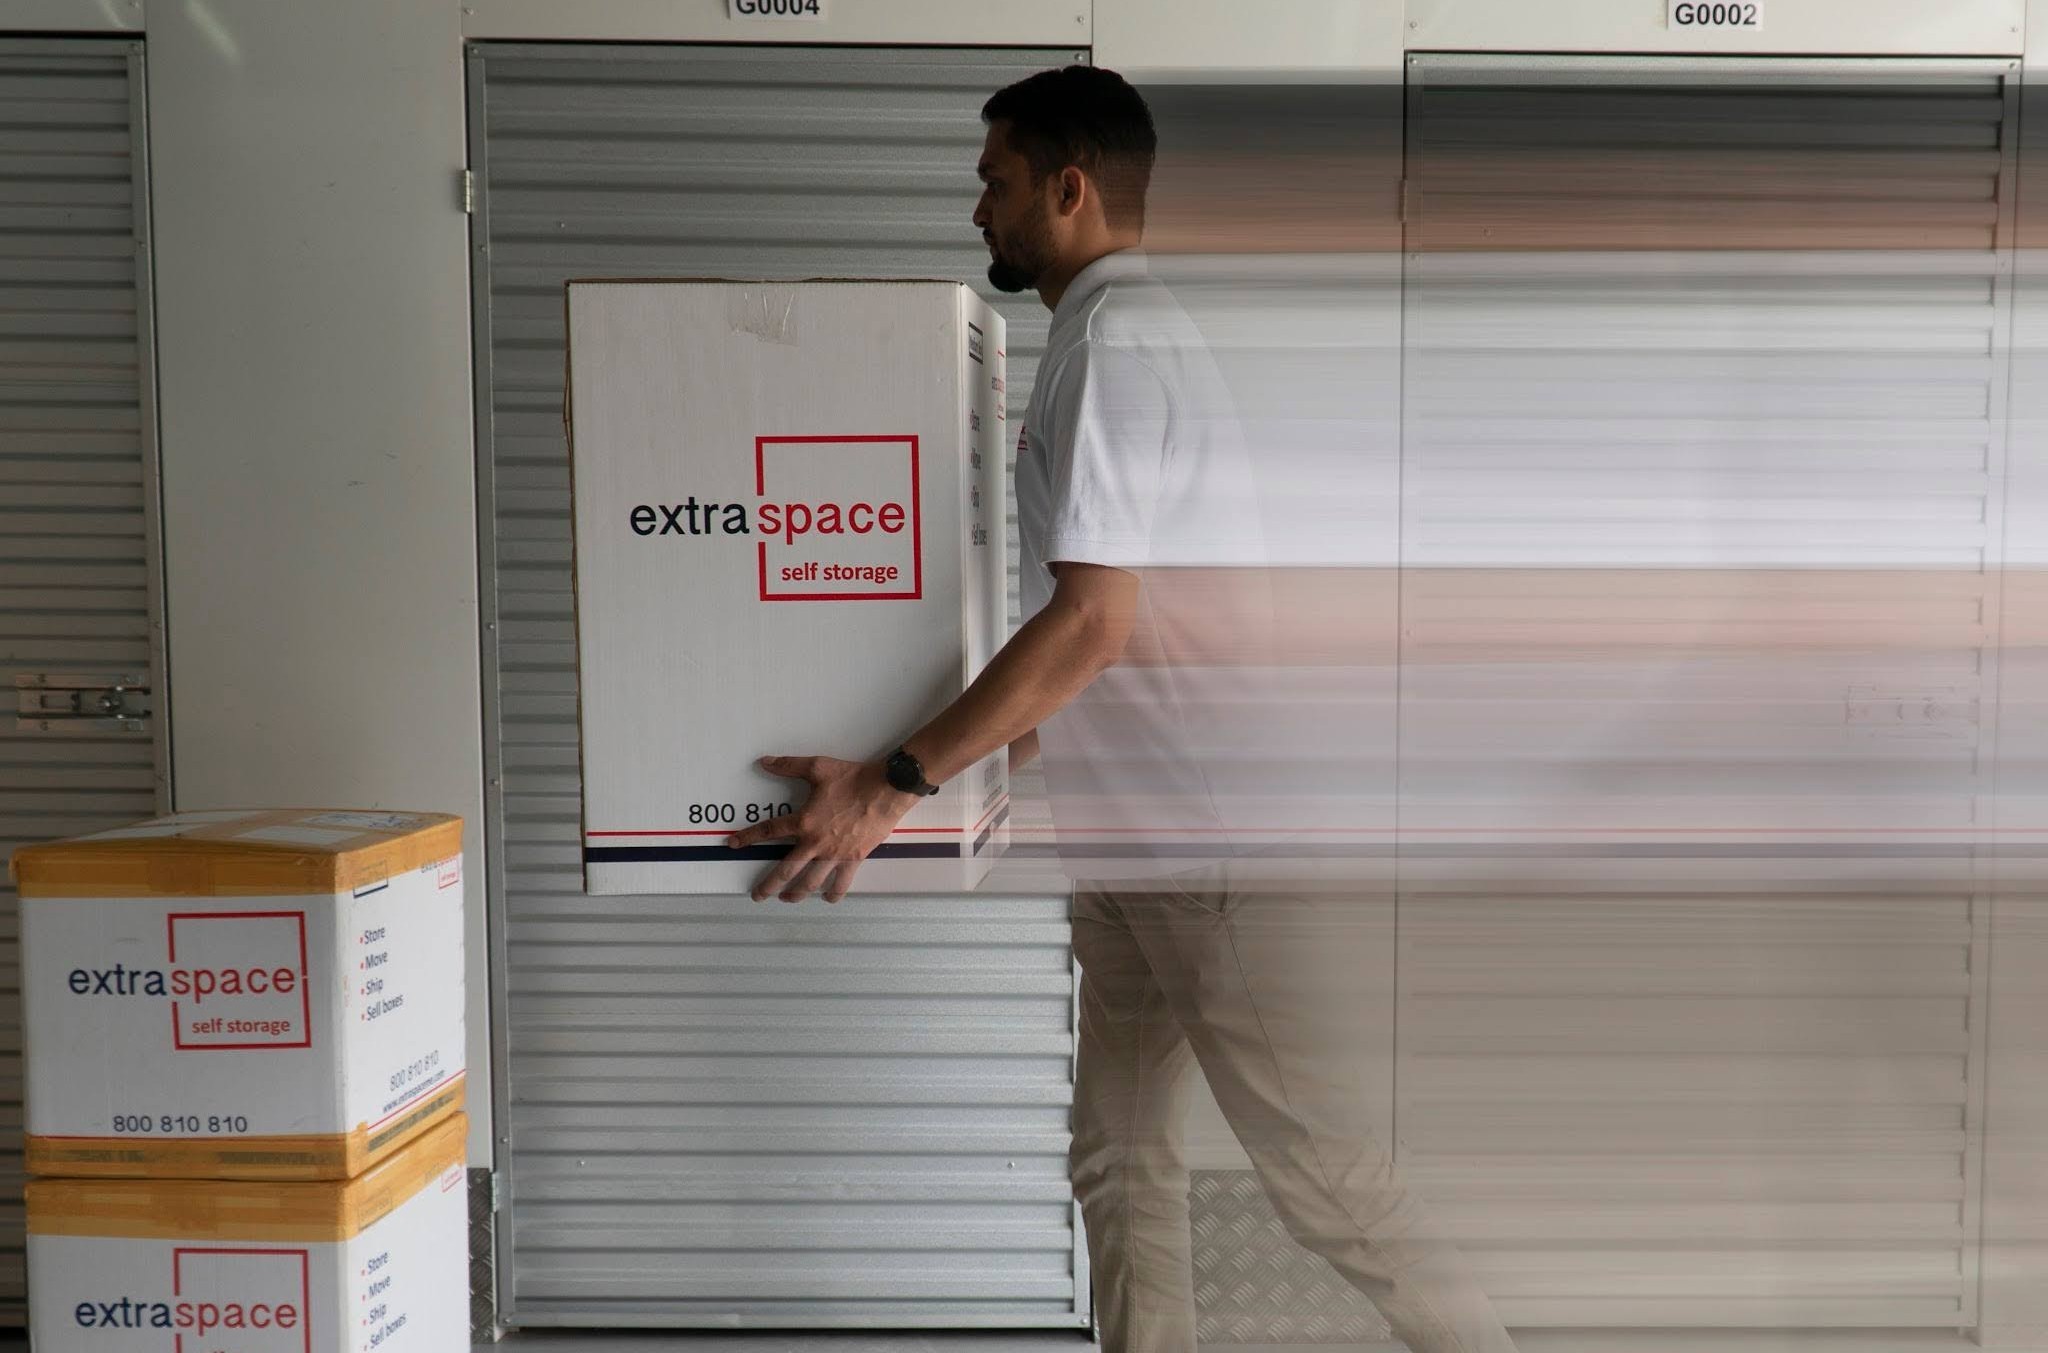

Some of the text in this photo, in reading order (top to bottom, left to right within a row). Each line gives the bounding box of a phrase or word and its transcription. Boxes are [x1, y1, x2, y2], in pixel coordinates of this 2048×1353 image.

[736, 0, 820, 15] G0004
[1675, 3, 1757, 25] G0002
[781, 563, 898, 585] self storage
[688, 803, 736, 824] 800
[364, 927, 386, 945] Store
[365, 951, 388, 970] Move
[366, 977, 384, 996] Ship
[366, 994, 404, 1021] Sell boxes
[192, 1018, 291, 1036] self storage
[113, 1115, 248, 1134] 800 810 810
[367, 1251, 389, 1275] Store
[368, 1275, 391, 1299] Move
[369, 1303, 387, 1325] Ship
[369, 1313, 407, 1350] Sell boxes
